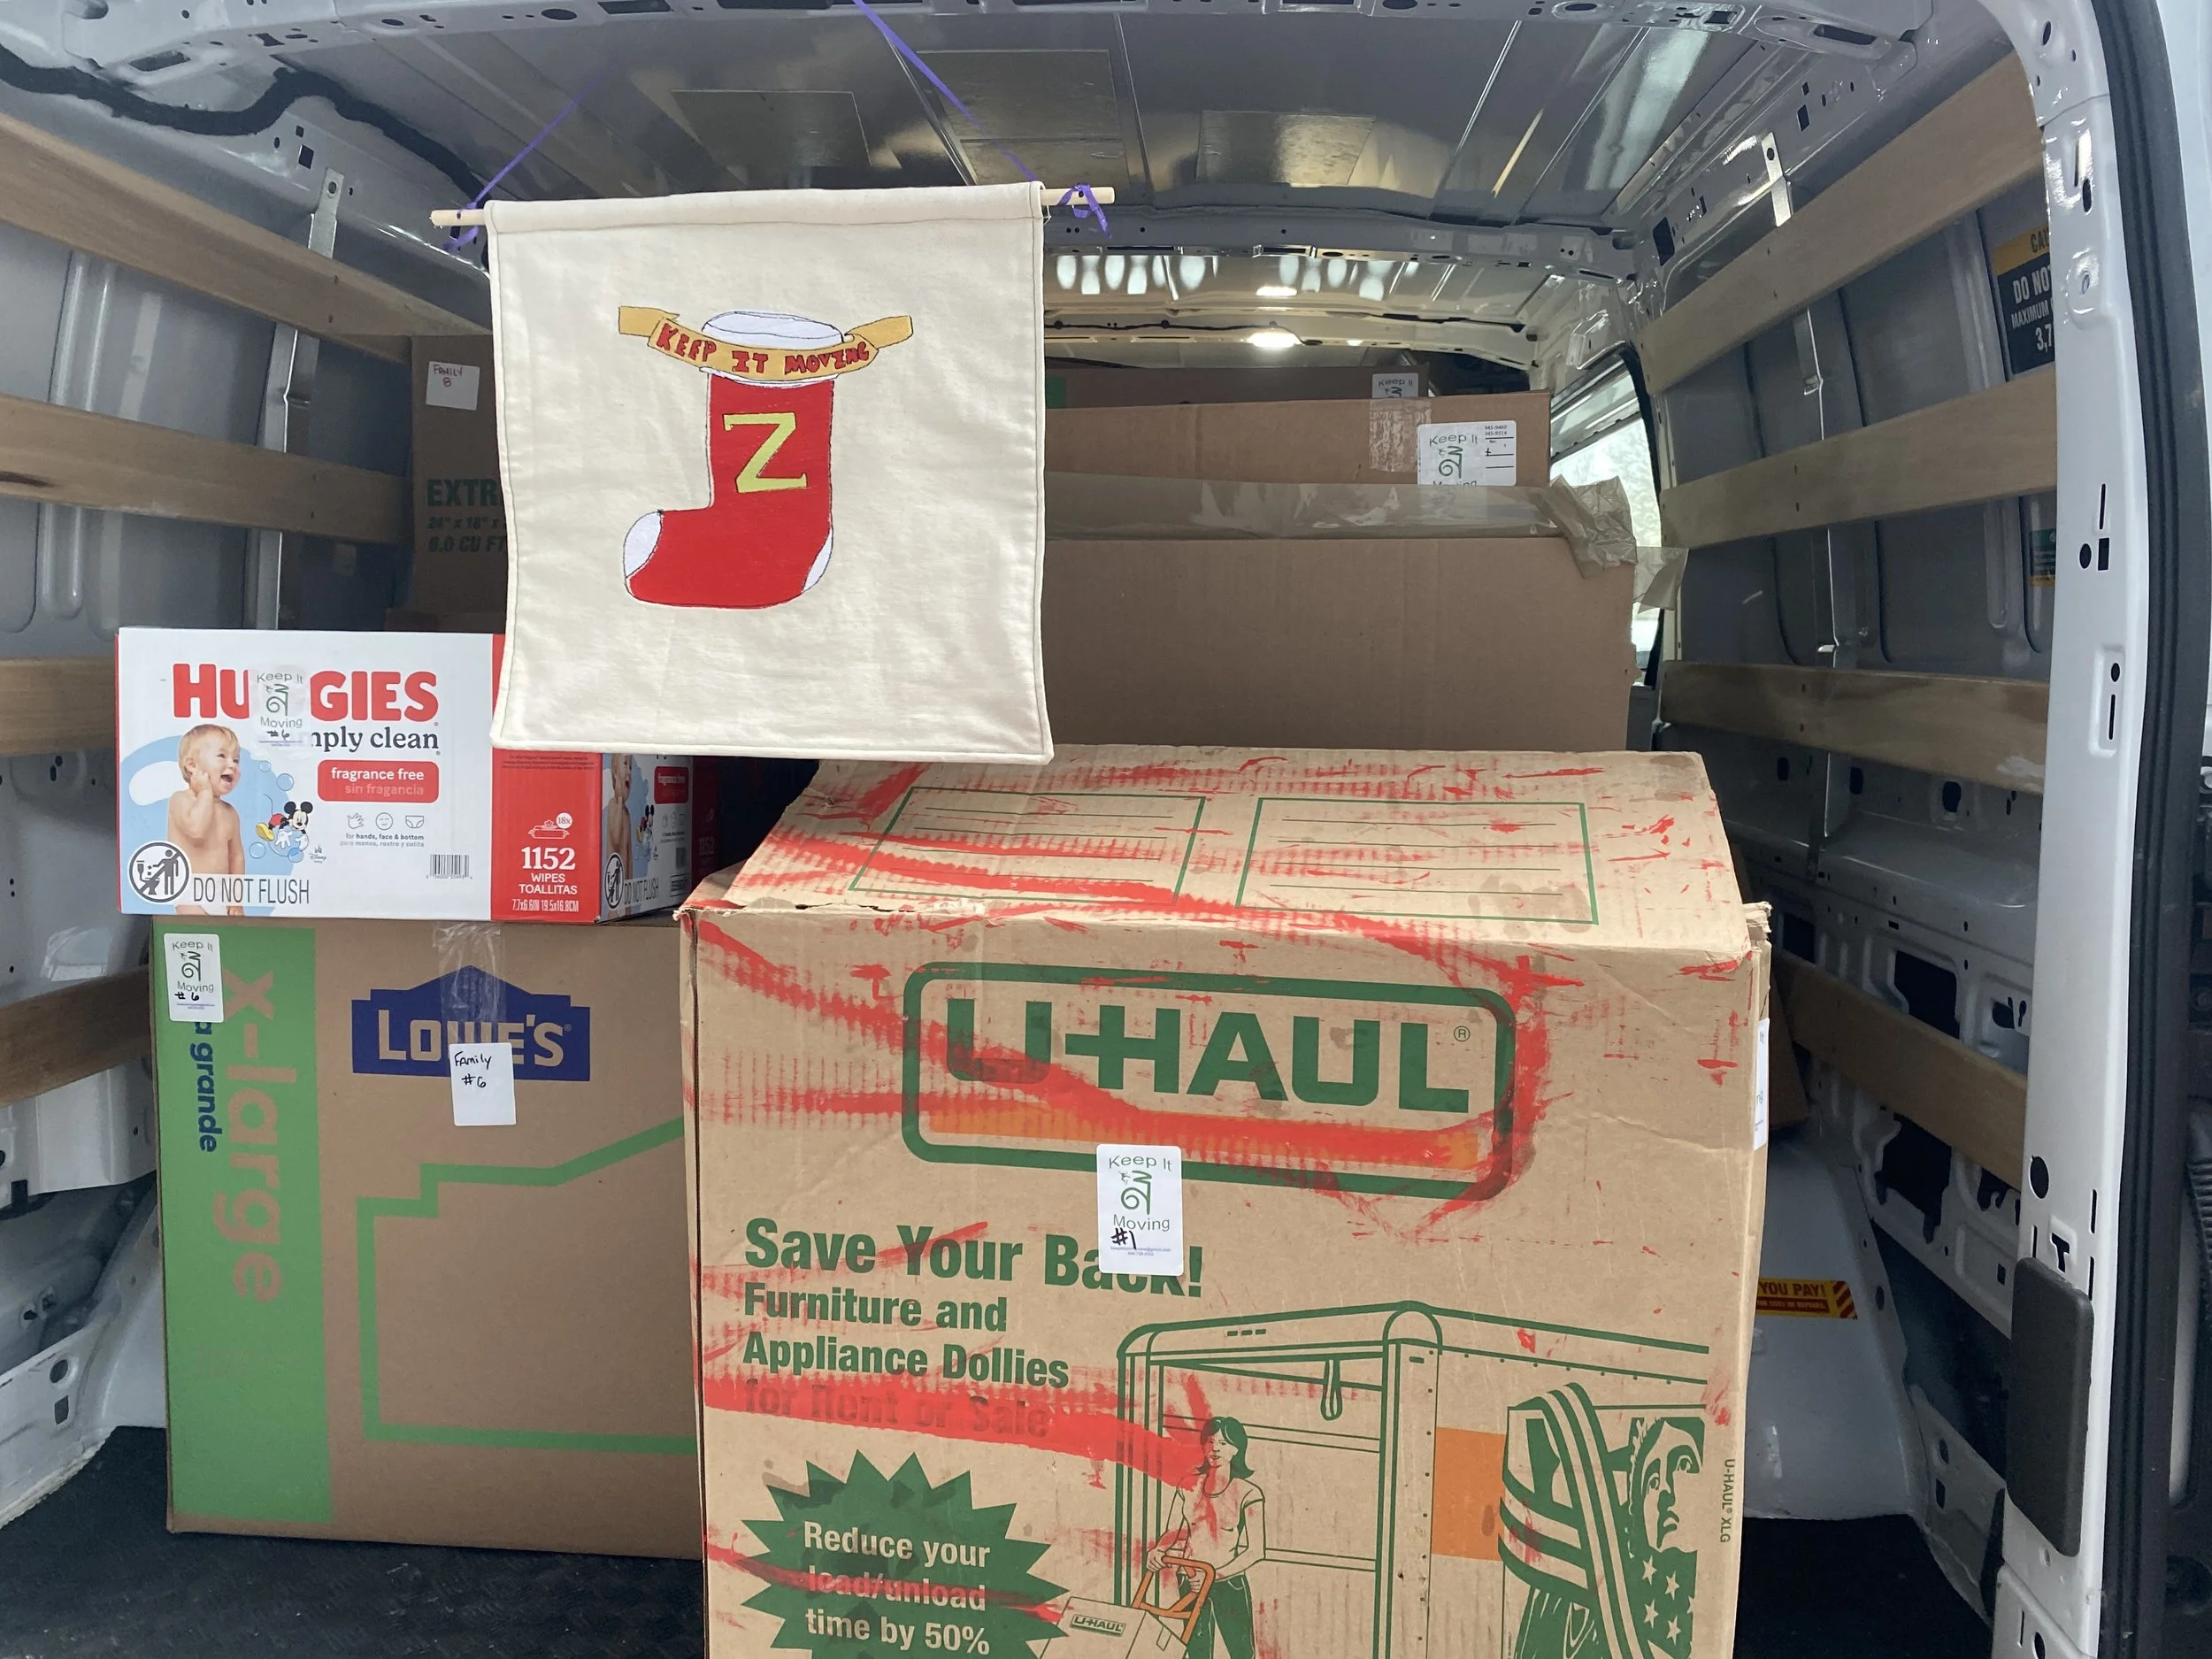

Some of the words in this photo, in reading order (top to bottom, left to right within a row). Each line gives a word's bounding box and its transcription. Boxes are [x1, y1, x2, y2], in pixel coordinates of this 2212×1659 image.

[2012, 275, 2031, 304] DO
[2032, 265, 2052, 296] NO
[2010, 299, 2050, 330] MAXIMUM
[656, 322, 718, 363] KEEP
[731, 349, 769, 373] IT
[784, 341, 870, 375] MOVING
[433, 364, 464, 377] FAMILY
[442, 376, 452, 388] 8
[1378, 378, 1406, 388] Keep
[722, 411, 808, 494] Z
[1429, 434, 1467, 447] Keep
[426, 479, 502, 507] EXTR
[458, 535, 482, 553] CU
[257, 672, 293, 684] Keep
[173, 663, 439, 722] HUGIES
[260, 716, 303, 729] Moving
[369, 726, 440, 749] clean
[331, 767, 395, 782] fragrance
[397, 768, 425, 780] free
[344, 783, 364, 795] sin
[366, 783, 425, 797] fragancia
[557, 816, 572, 826] 18x
[520, 846, 576, 871] 1152
[518, 884, 578, 895] TOALLITAS
[530, 872, 566, 883] WIPES
[193, 877, 216, 903] DO
[221, 878, 254, 903] NOT
[258, 879, 310, 904] FLUSH
[172, 941, 204, 951] Keep
[177, 980, 214, 994] Moving
[946, 997, 1470, 1114] U-HAUL
[189, 1042, 223, 1153] grande
[214, 965, 297, 1302] x-large
[1109, 1155, 1157, 1169] Keep
[1163, 1157, 1172, 1171] It
[1113, 1213, 1171, 1233] Moving
[745, 1217, 877, 1275] Save
[896, 1225, 1023, 1281] Your
[1110, 1226, 1137, 1250] #1
[1758, 1281, 1789, 1296] YOU
[1793, 1283, 1828, 1297] PAY!
[743, 1282, 923, 1326] Furniture
[935, 1296, 1008, 1333] and
[742, 1331, 929, 1377] Appliance
[942, 1343, 1071, 1389] Dollies
[742, 1378, 794, 1416] for
[810, 1384, 900, 1425] Rent
[968, 1395, 1050, 1438] Sale
[1721, 1458, 1737, 1509] U-HAUL
[1719, 1517, 1732, 1543] XLG
[803, 1520, 913, 1560] Reduce
[922, 1540, 991, 1568] your
[809, 1564, 986, 1611] load/unload
[805, 1608, 871, 1640] time
[880, 1616, 916, 1651] by
[925, 1622, 990, 1655] 50%
[1073, 1616, 1123, 1632] U-HAUL
